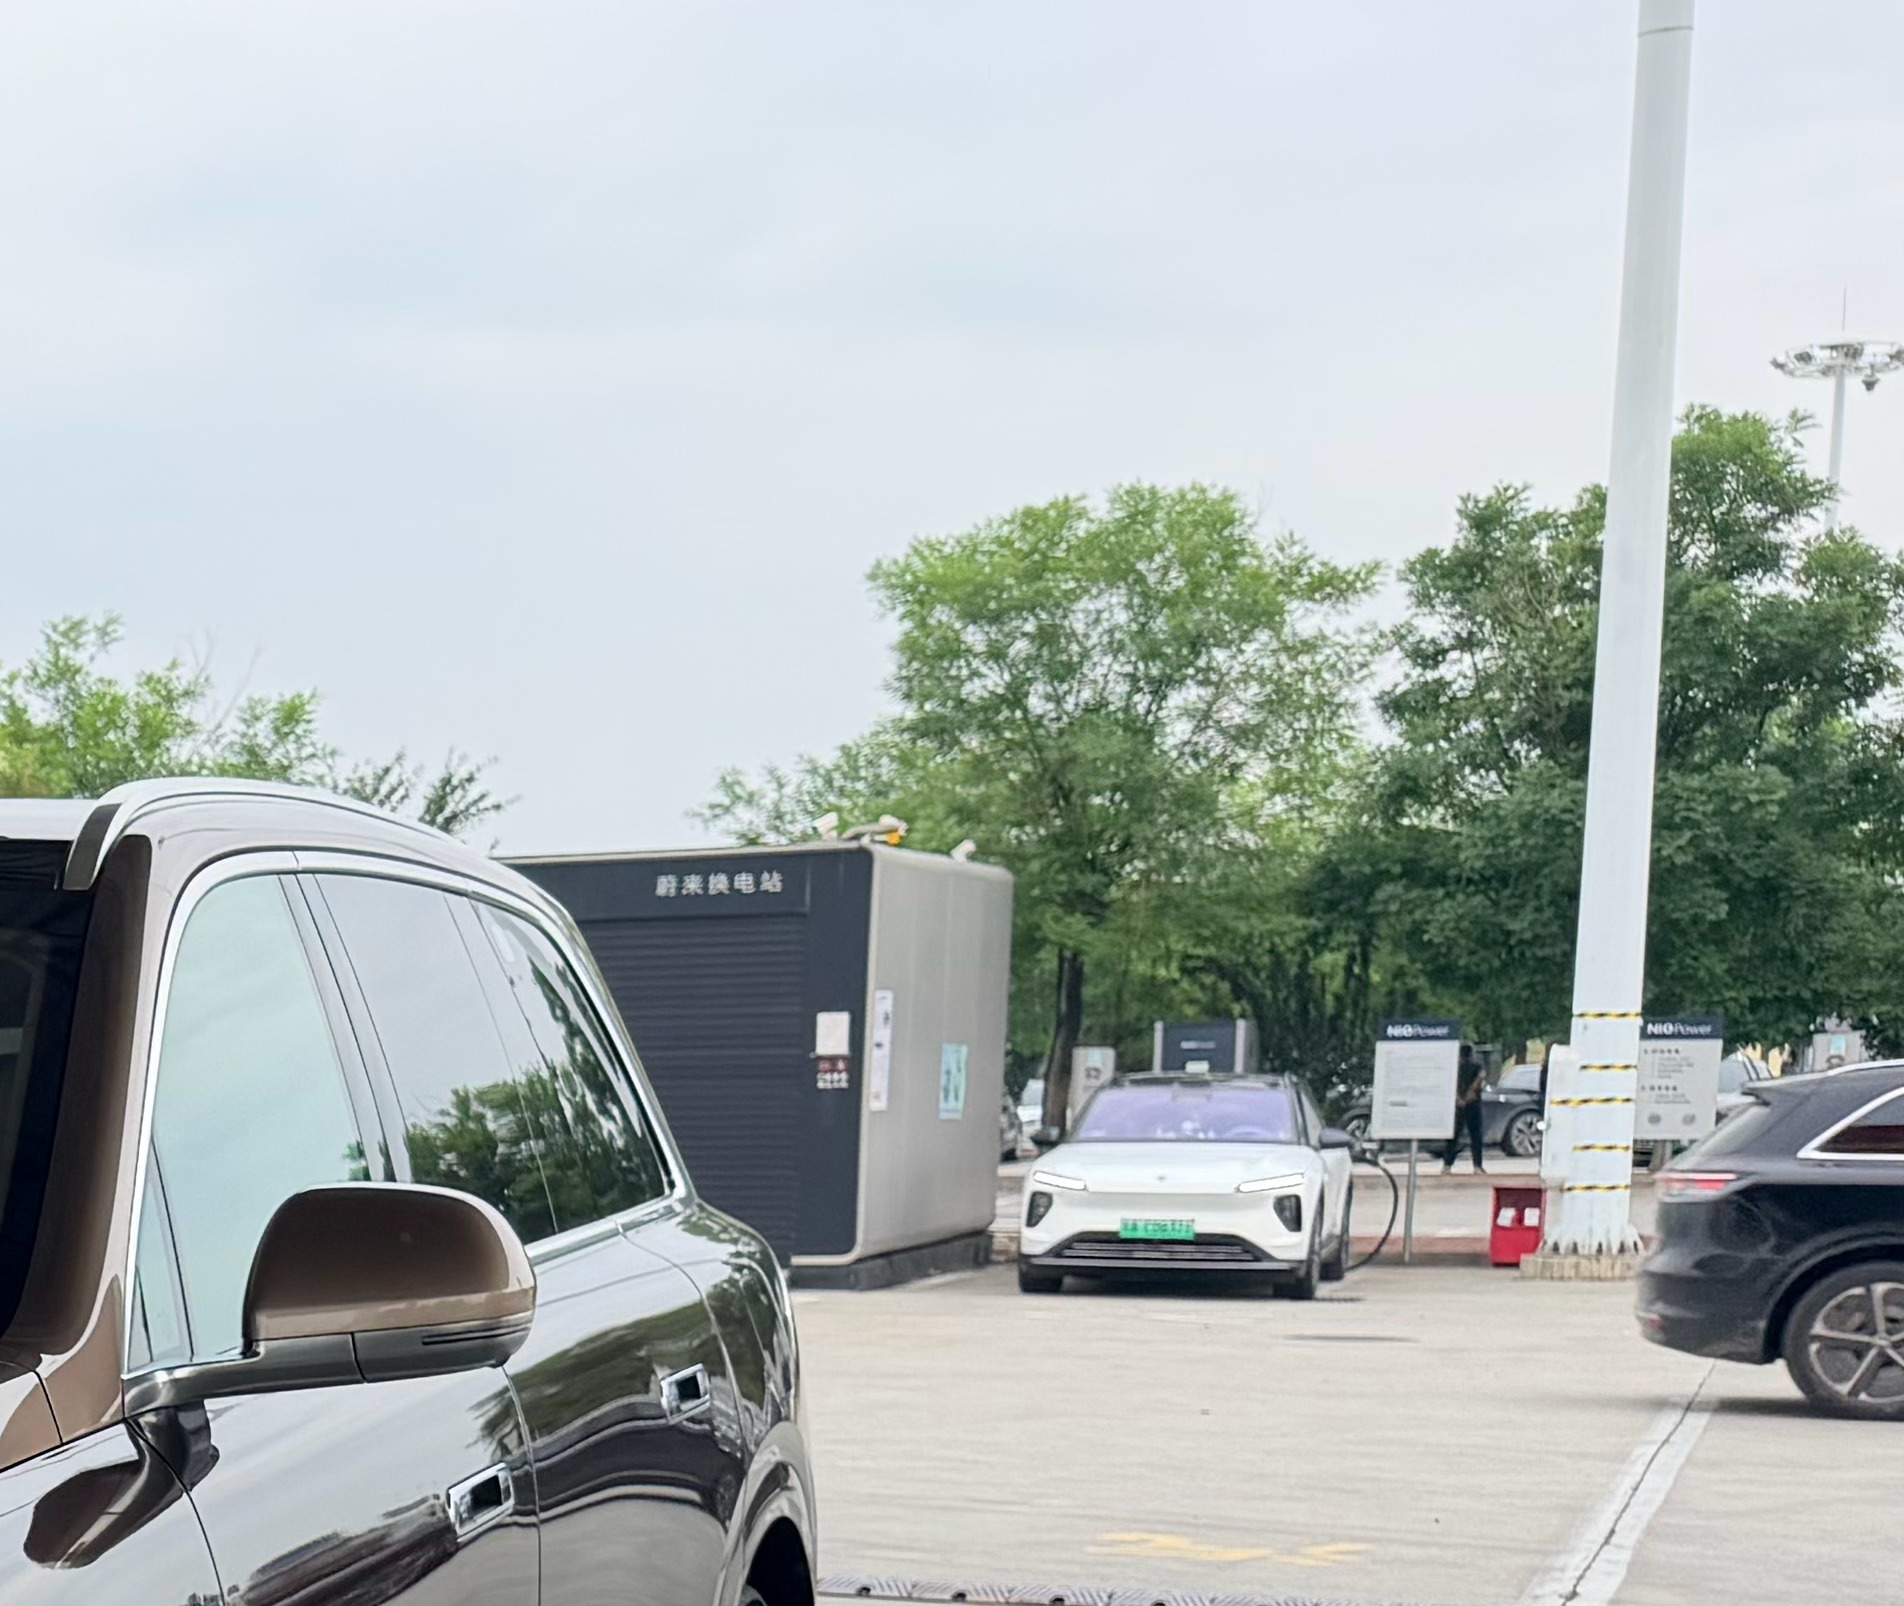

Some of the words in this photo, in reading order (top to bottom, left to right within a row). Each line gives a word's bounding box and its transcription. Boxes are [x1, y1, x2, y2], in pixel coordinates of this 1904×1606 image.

[655, 869, 783, 897] 蔚来换电站
